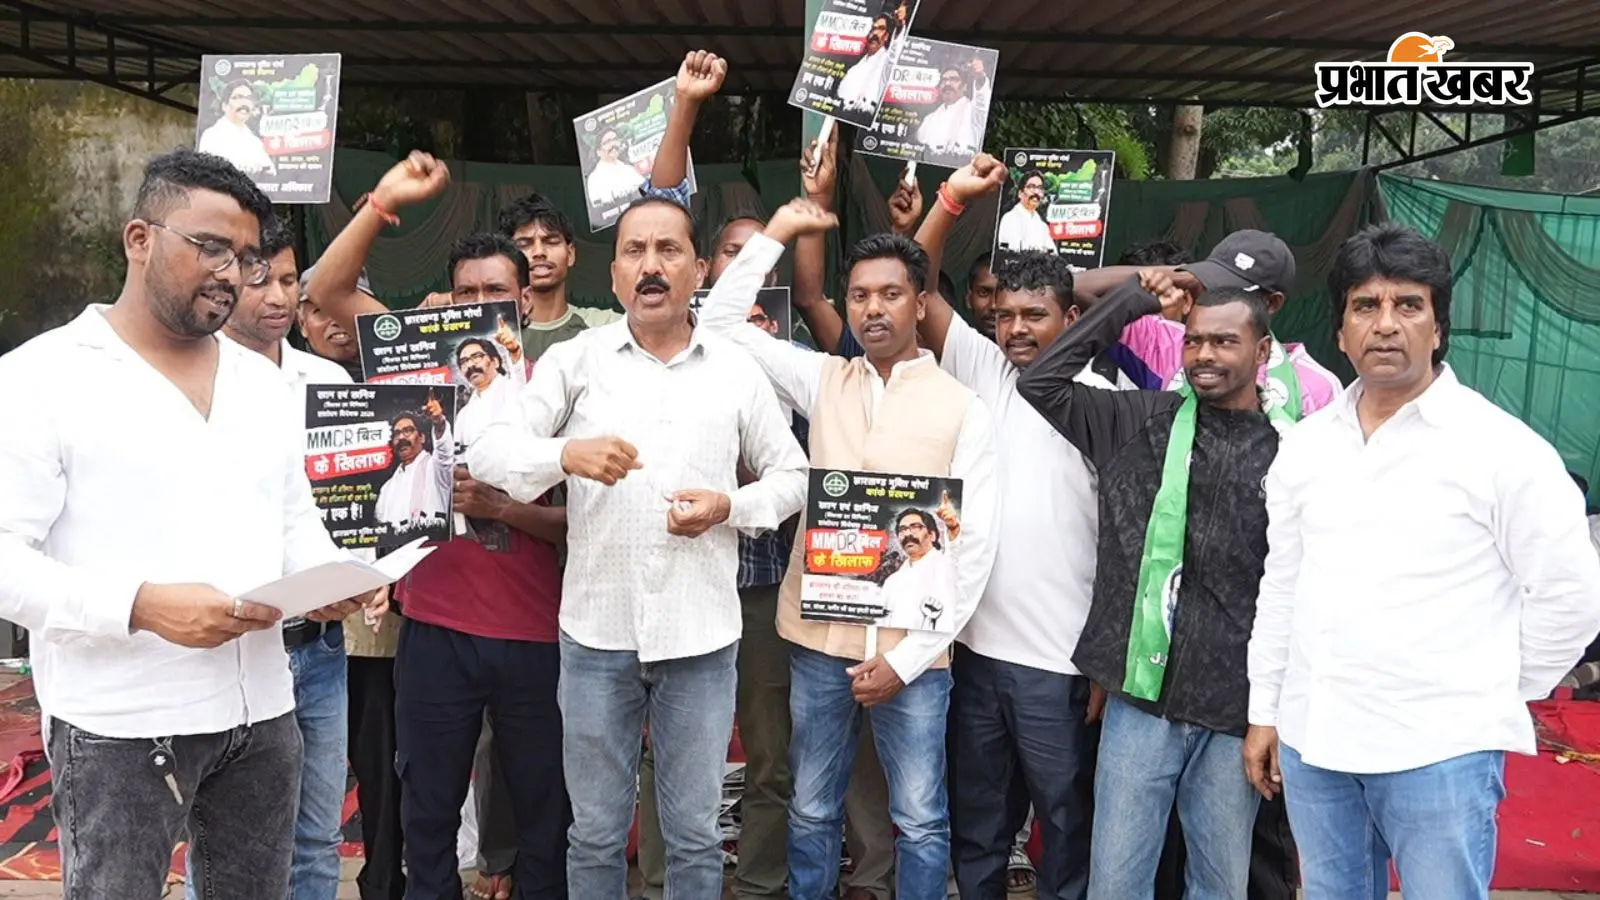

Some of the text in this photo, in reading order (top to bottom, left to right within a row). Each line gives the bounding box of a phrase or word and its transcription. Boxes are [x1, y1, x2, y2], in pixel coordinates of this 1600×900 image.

[404, 313, 439, 325] झारखण्ड
[441, 309, 461, 324] मुक्ति
[357, 427, 382, 443] बिल
[313, 452, 387, 474] के खिलाफ
[853, 476, 929, 490] झारखण्ड मुक्ति मोर्चा
[331, 508, 348, 521] एक
[811, 532, 858, 552] MMDR
[813, 552, 874, 568] के खिलाफ
